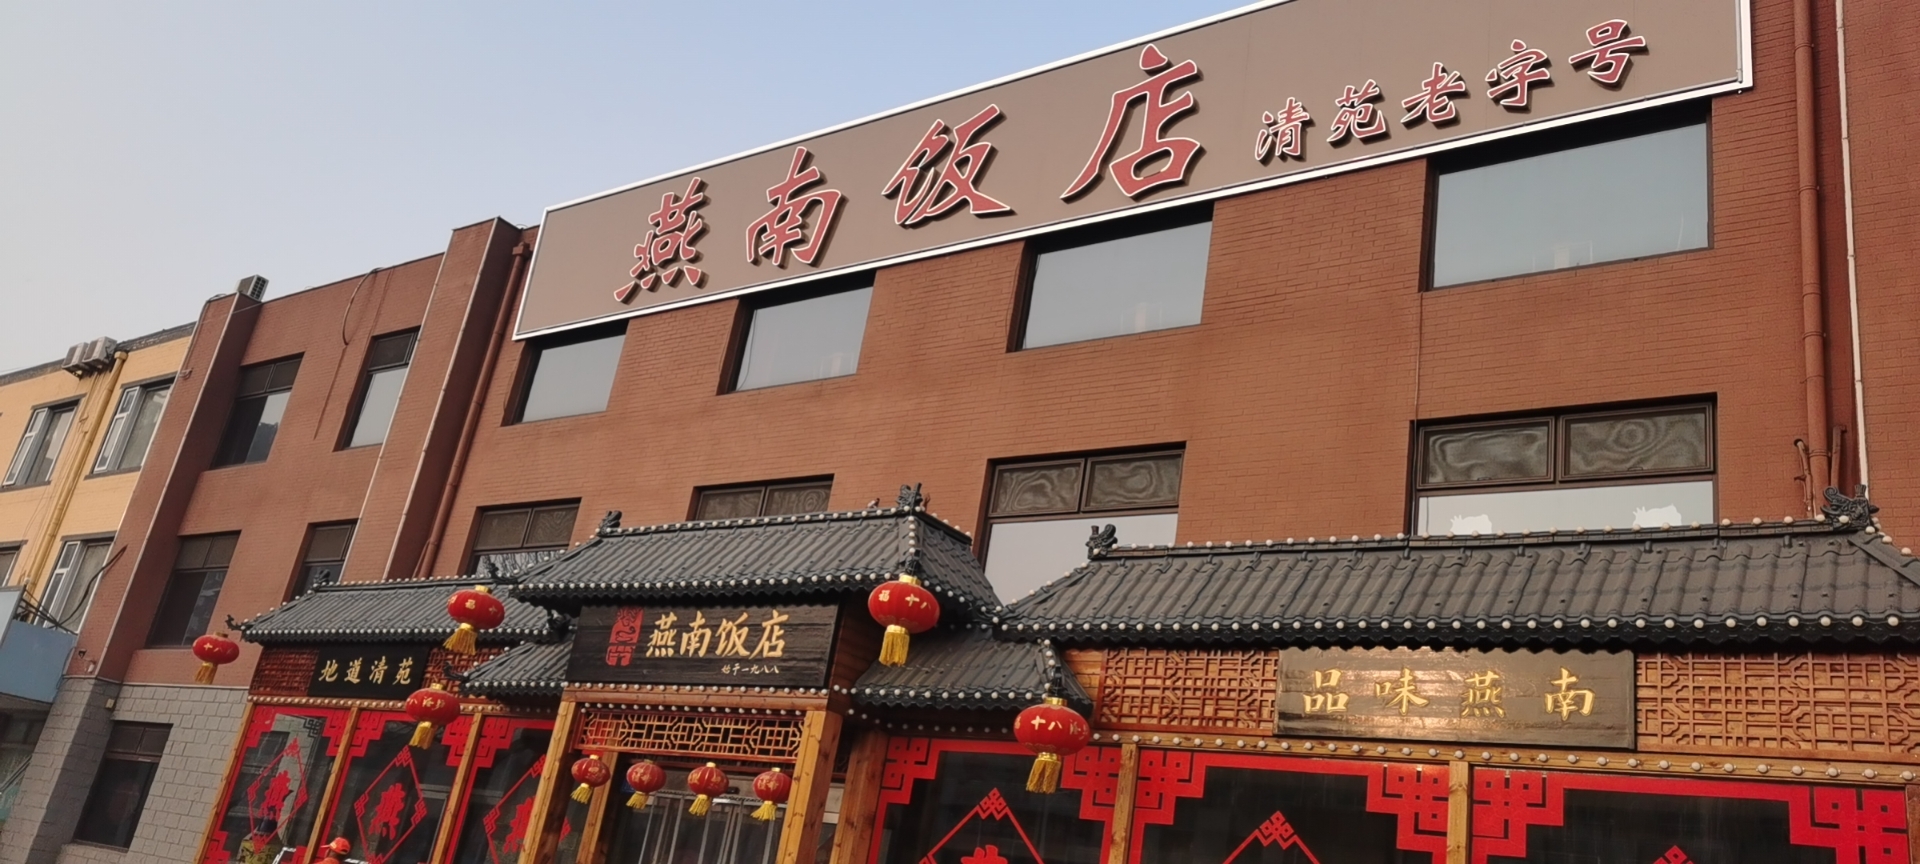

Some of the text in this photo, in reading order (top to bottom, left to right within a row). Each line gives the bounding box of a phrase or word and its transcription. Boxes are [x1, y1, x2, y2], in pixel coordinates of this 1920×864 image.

[1254, 18, 1647, 162] 清苑老字号
[614, 44, 1201, 303] 燕南饭店
[645, 609, 790, 660] 燕南饭店
[318, 655, 413, 686] 地道清苑
[1302, 666, 1596, 721] 品味燕南
